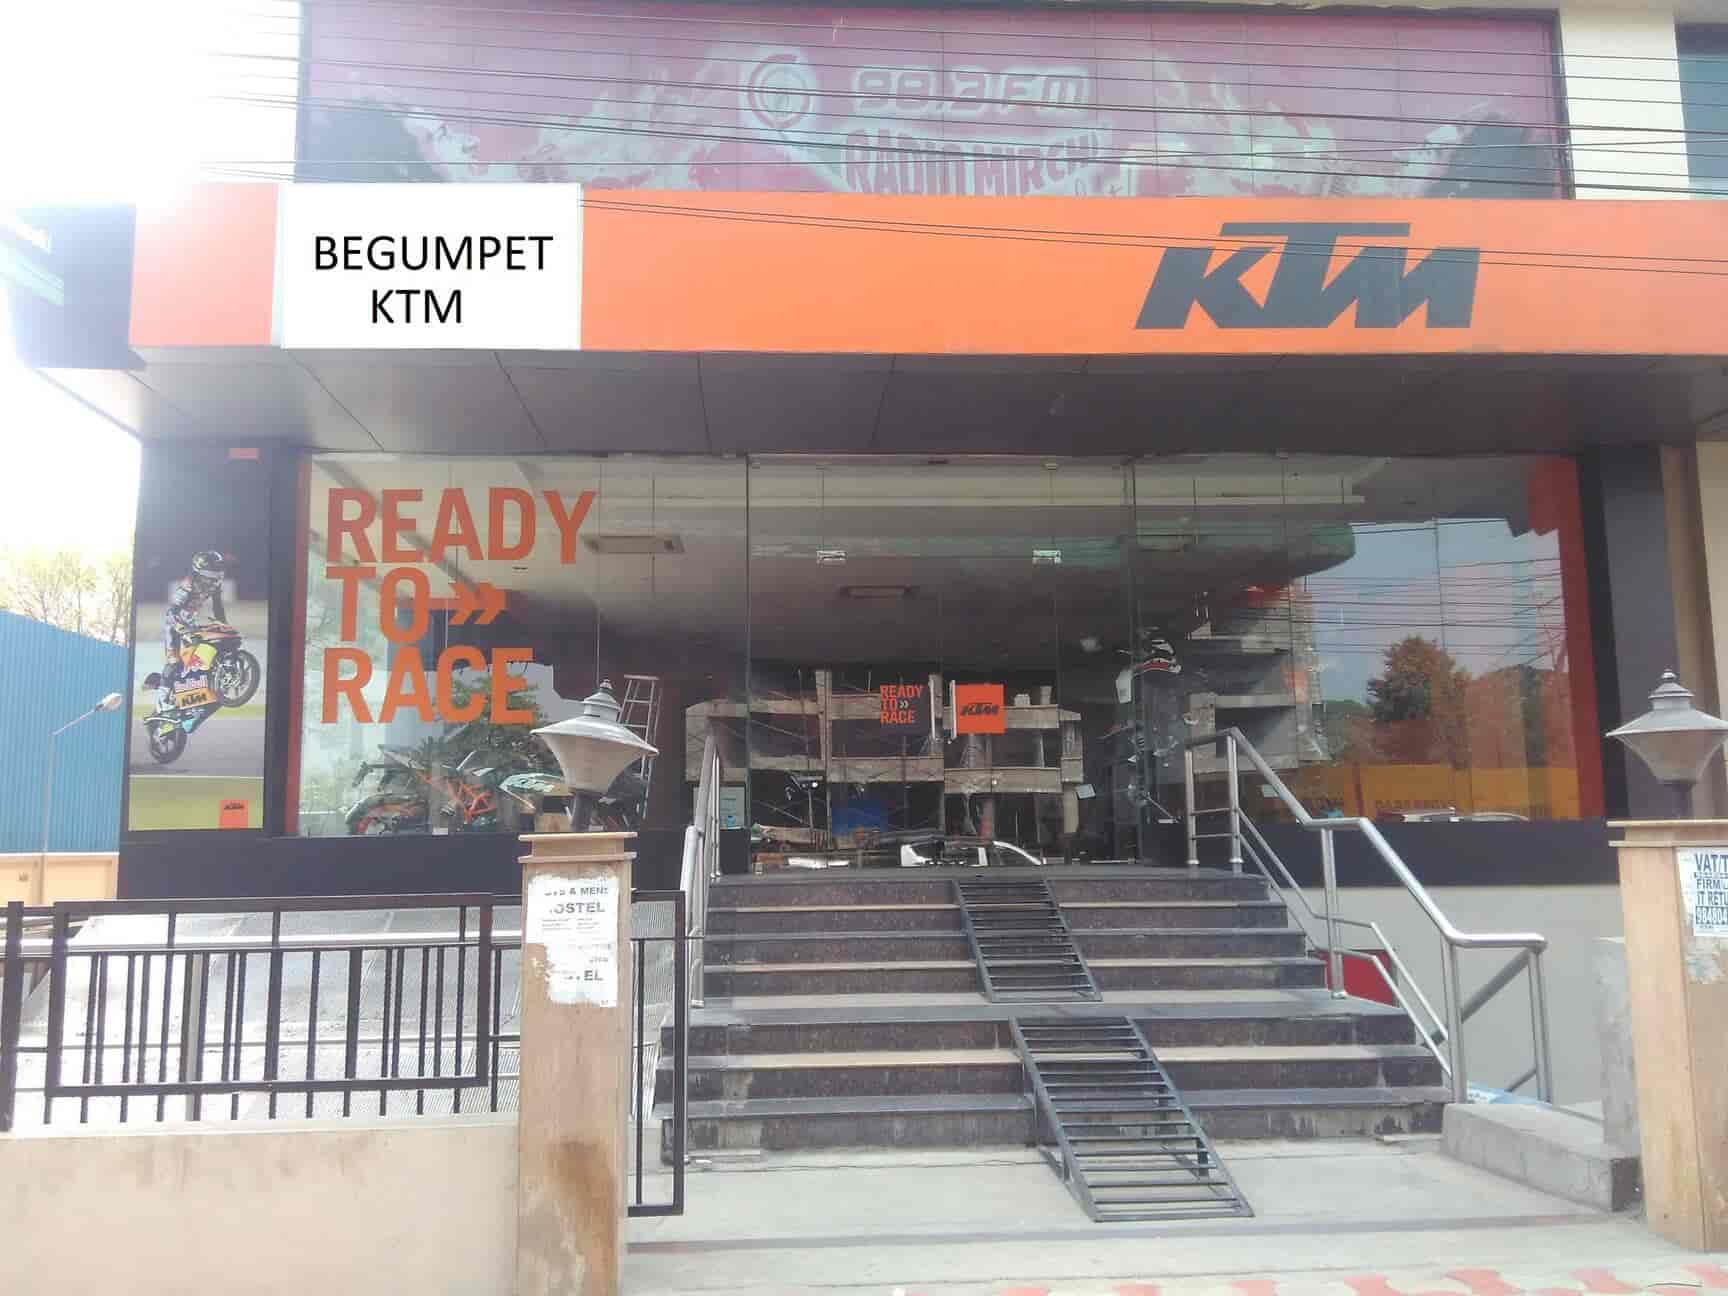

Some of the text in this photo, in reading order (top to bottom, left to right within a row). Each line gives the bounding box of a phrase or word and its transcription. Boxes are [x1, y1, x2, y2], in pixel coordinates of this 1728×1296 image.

[1135, 223, 1480, 329] KTM
[325, 487, 598, 565] READY
[325, 566, 431, 644] TO
[320, 645, 537, 725] RACE
[880, 685, 923, 698] READY
[880, 698, 897, 711] TO
[880, 710, 915, 724] RACE
[549, 902, 606, 914] OSTEL
